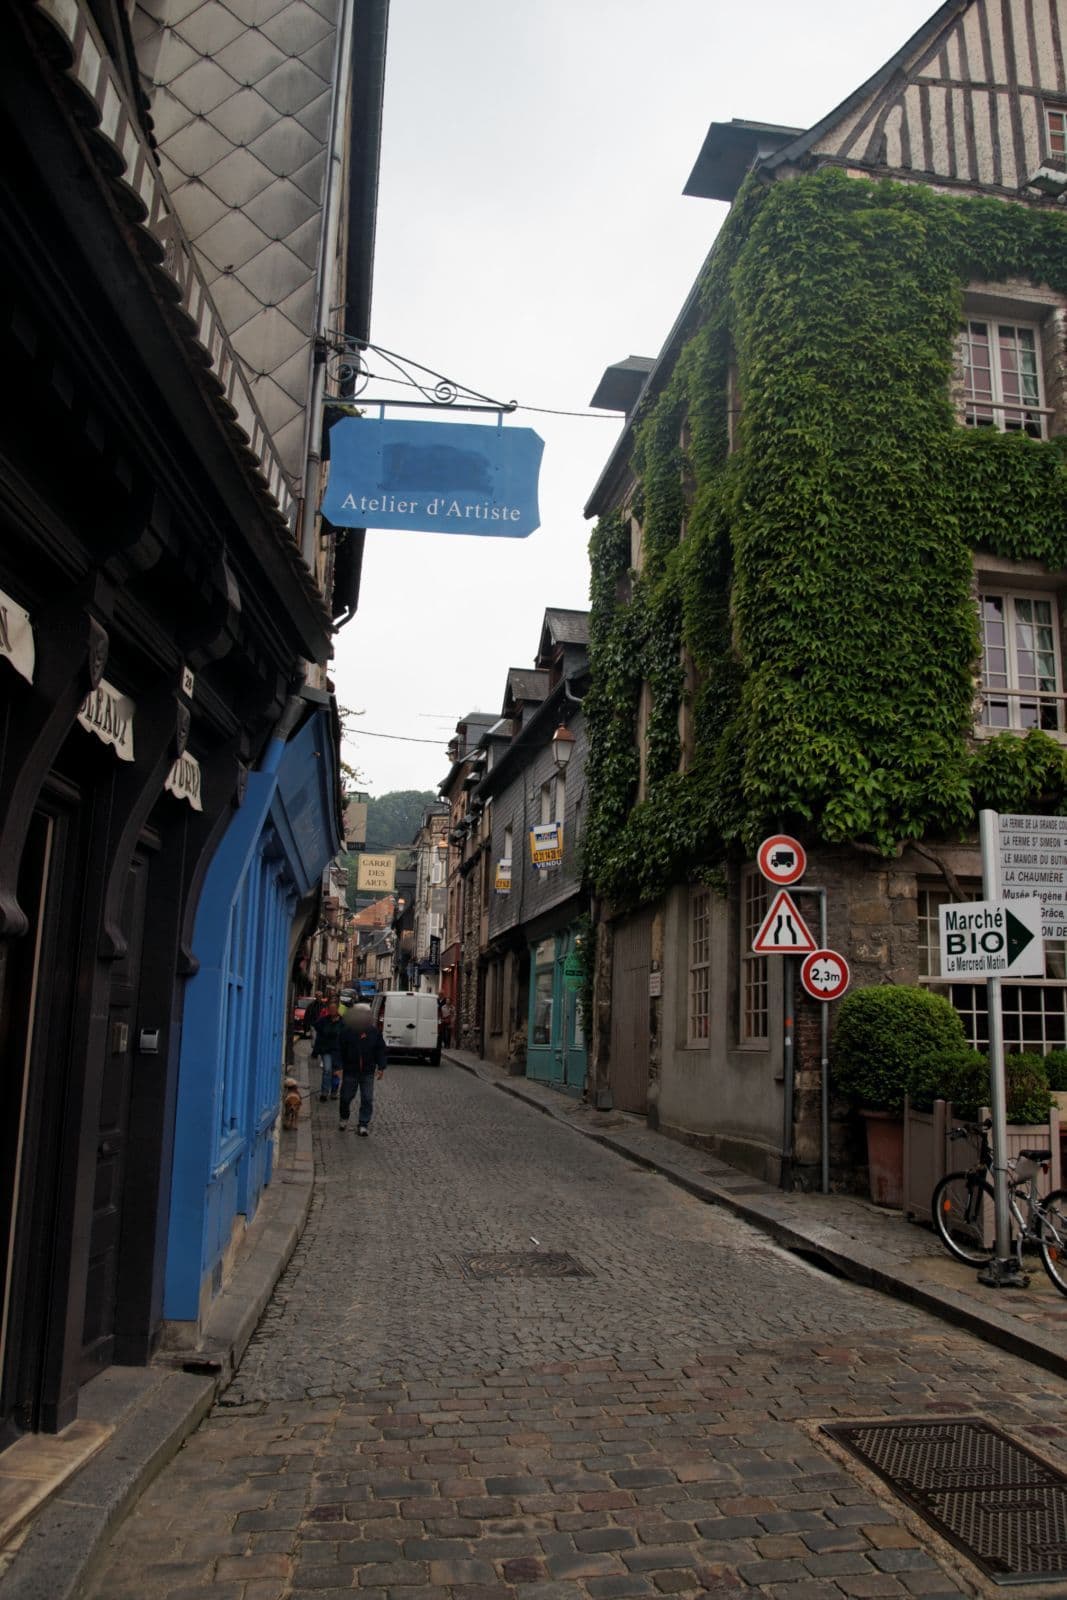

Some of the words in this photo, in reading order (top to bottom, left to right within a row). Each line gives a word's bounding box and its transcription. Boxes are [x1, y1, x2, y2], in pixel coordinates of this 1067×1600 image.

[341, 493, 418, 514] Atelier
[426, 499, 521, 521] d'Artiste
[1012, 836, 1030, 846] FERME
[1005, 853, 1011, 863] LE
[1013, 854, 1037, 864] MANOIR
[1005, 872, 1015, 881] LA
[1018, 871, 1063, 883] CHAUMIÈRE
[1003, 889, 1030, 899] Musée
[946, 907, 1002, 930] Marché
[947, 931, 1004, 955] BIO
[947, 957, 955, 972] Le
[956, 956, 985, 971] Mercredi
[987, 955, 1005, 970] Matin
[811, 968, 840, 983] 2,3m
